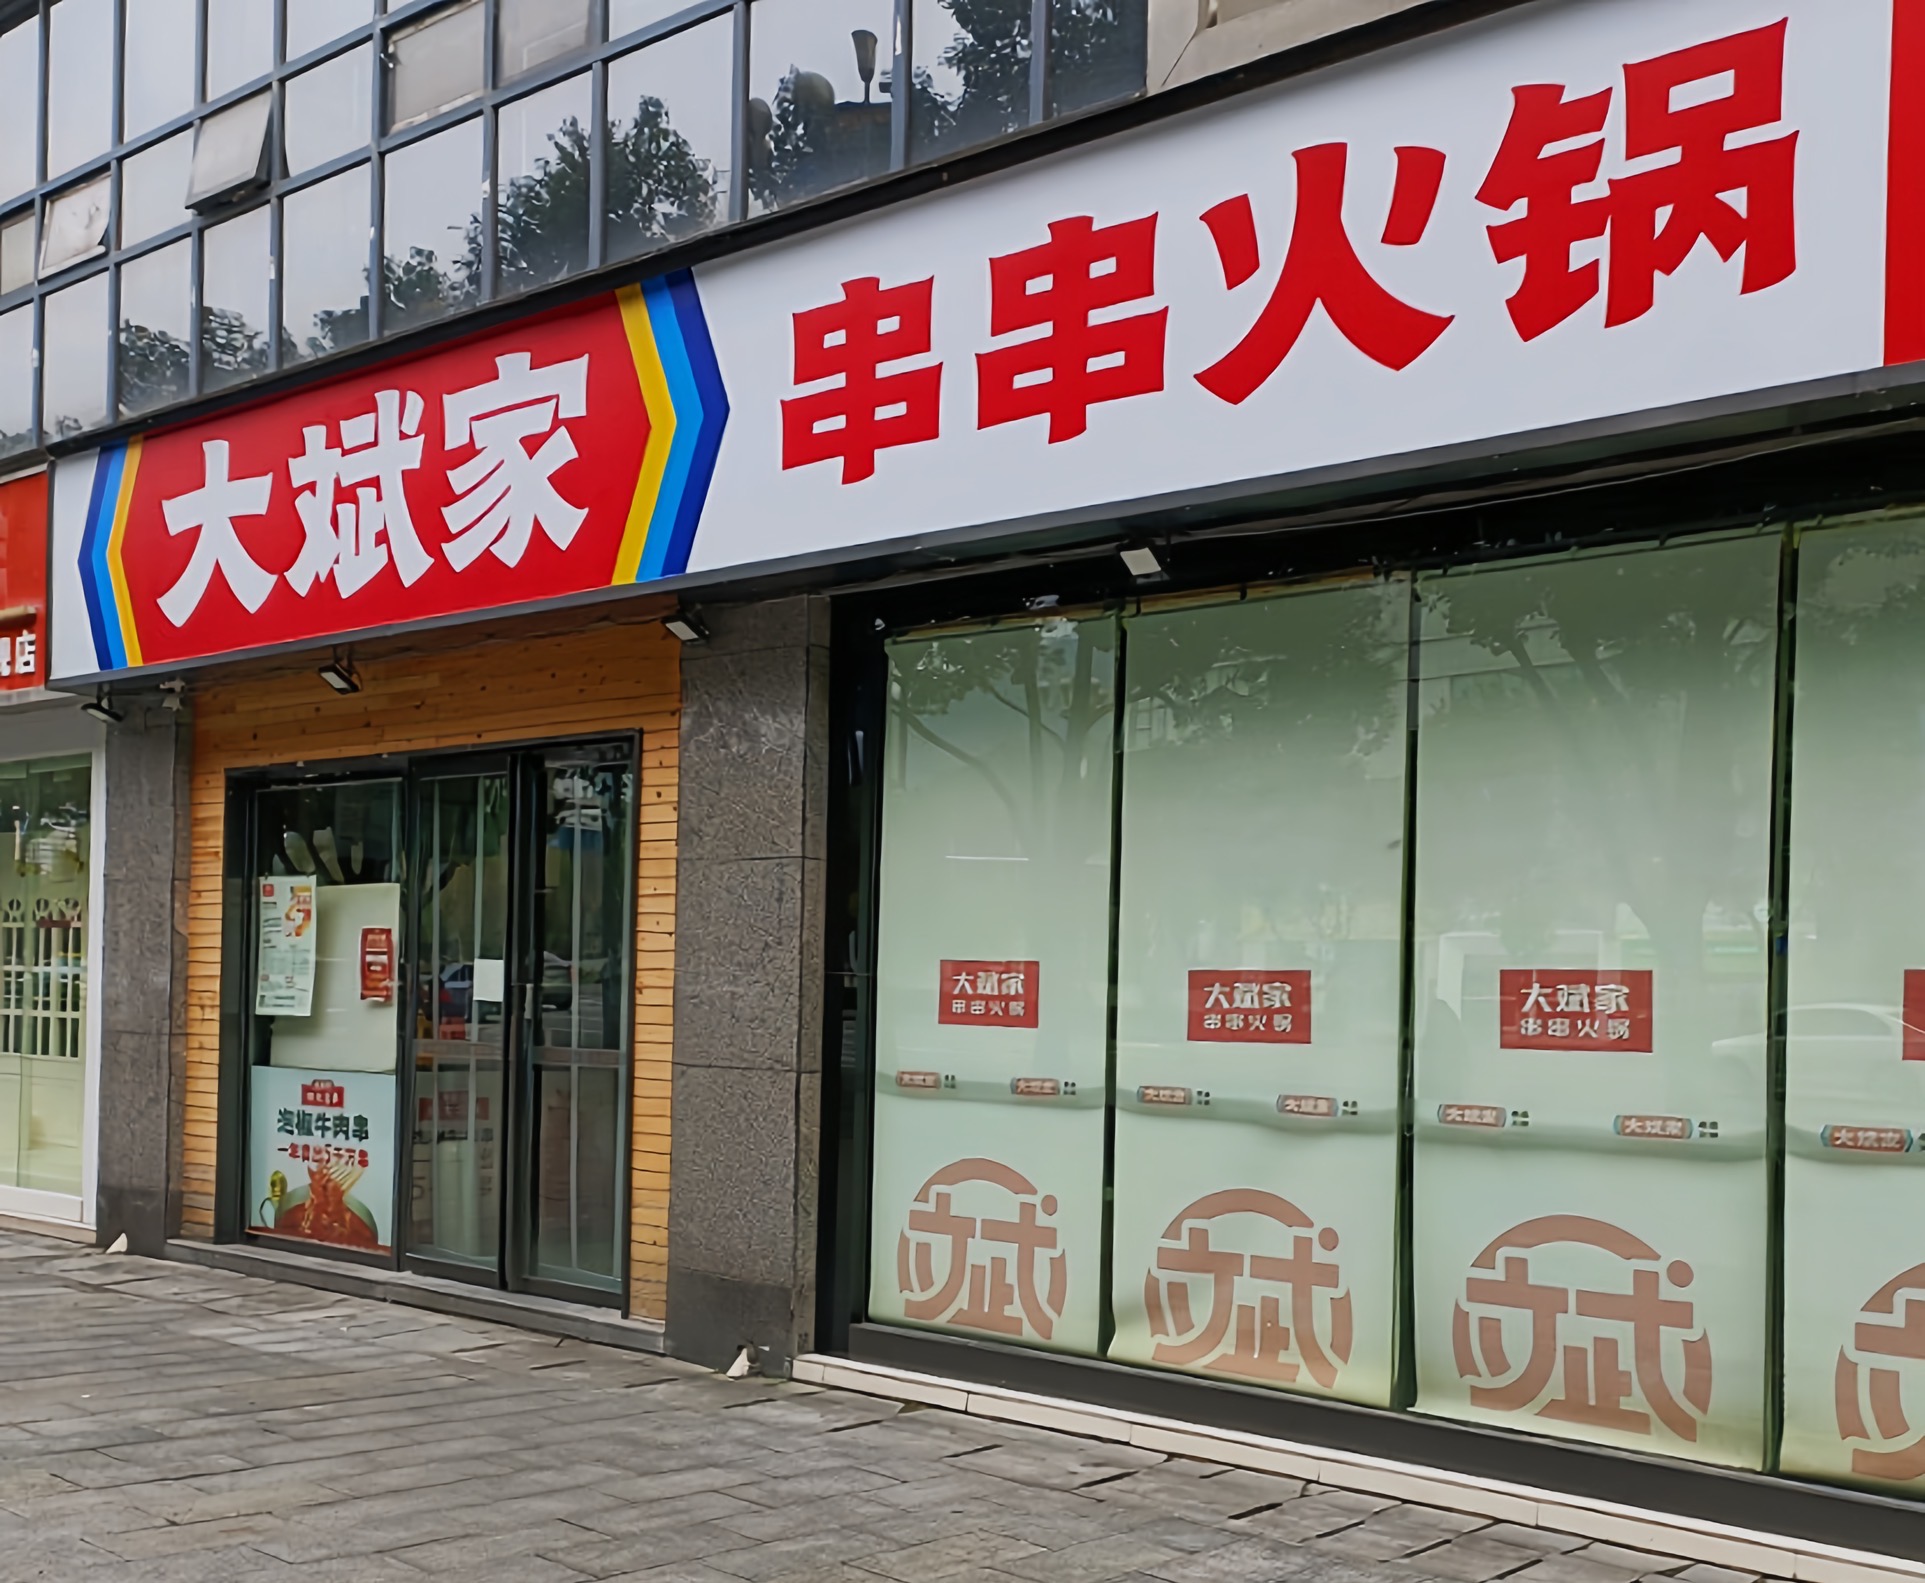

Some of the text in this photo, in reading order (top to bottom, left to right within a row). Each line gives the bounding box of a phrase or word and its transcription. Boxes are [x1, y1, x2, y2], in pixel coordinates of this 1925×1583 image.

[780, 16, 1799, 485] 串串火锅
[156, 352, 589, 628] 大斌家
